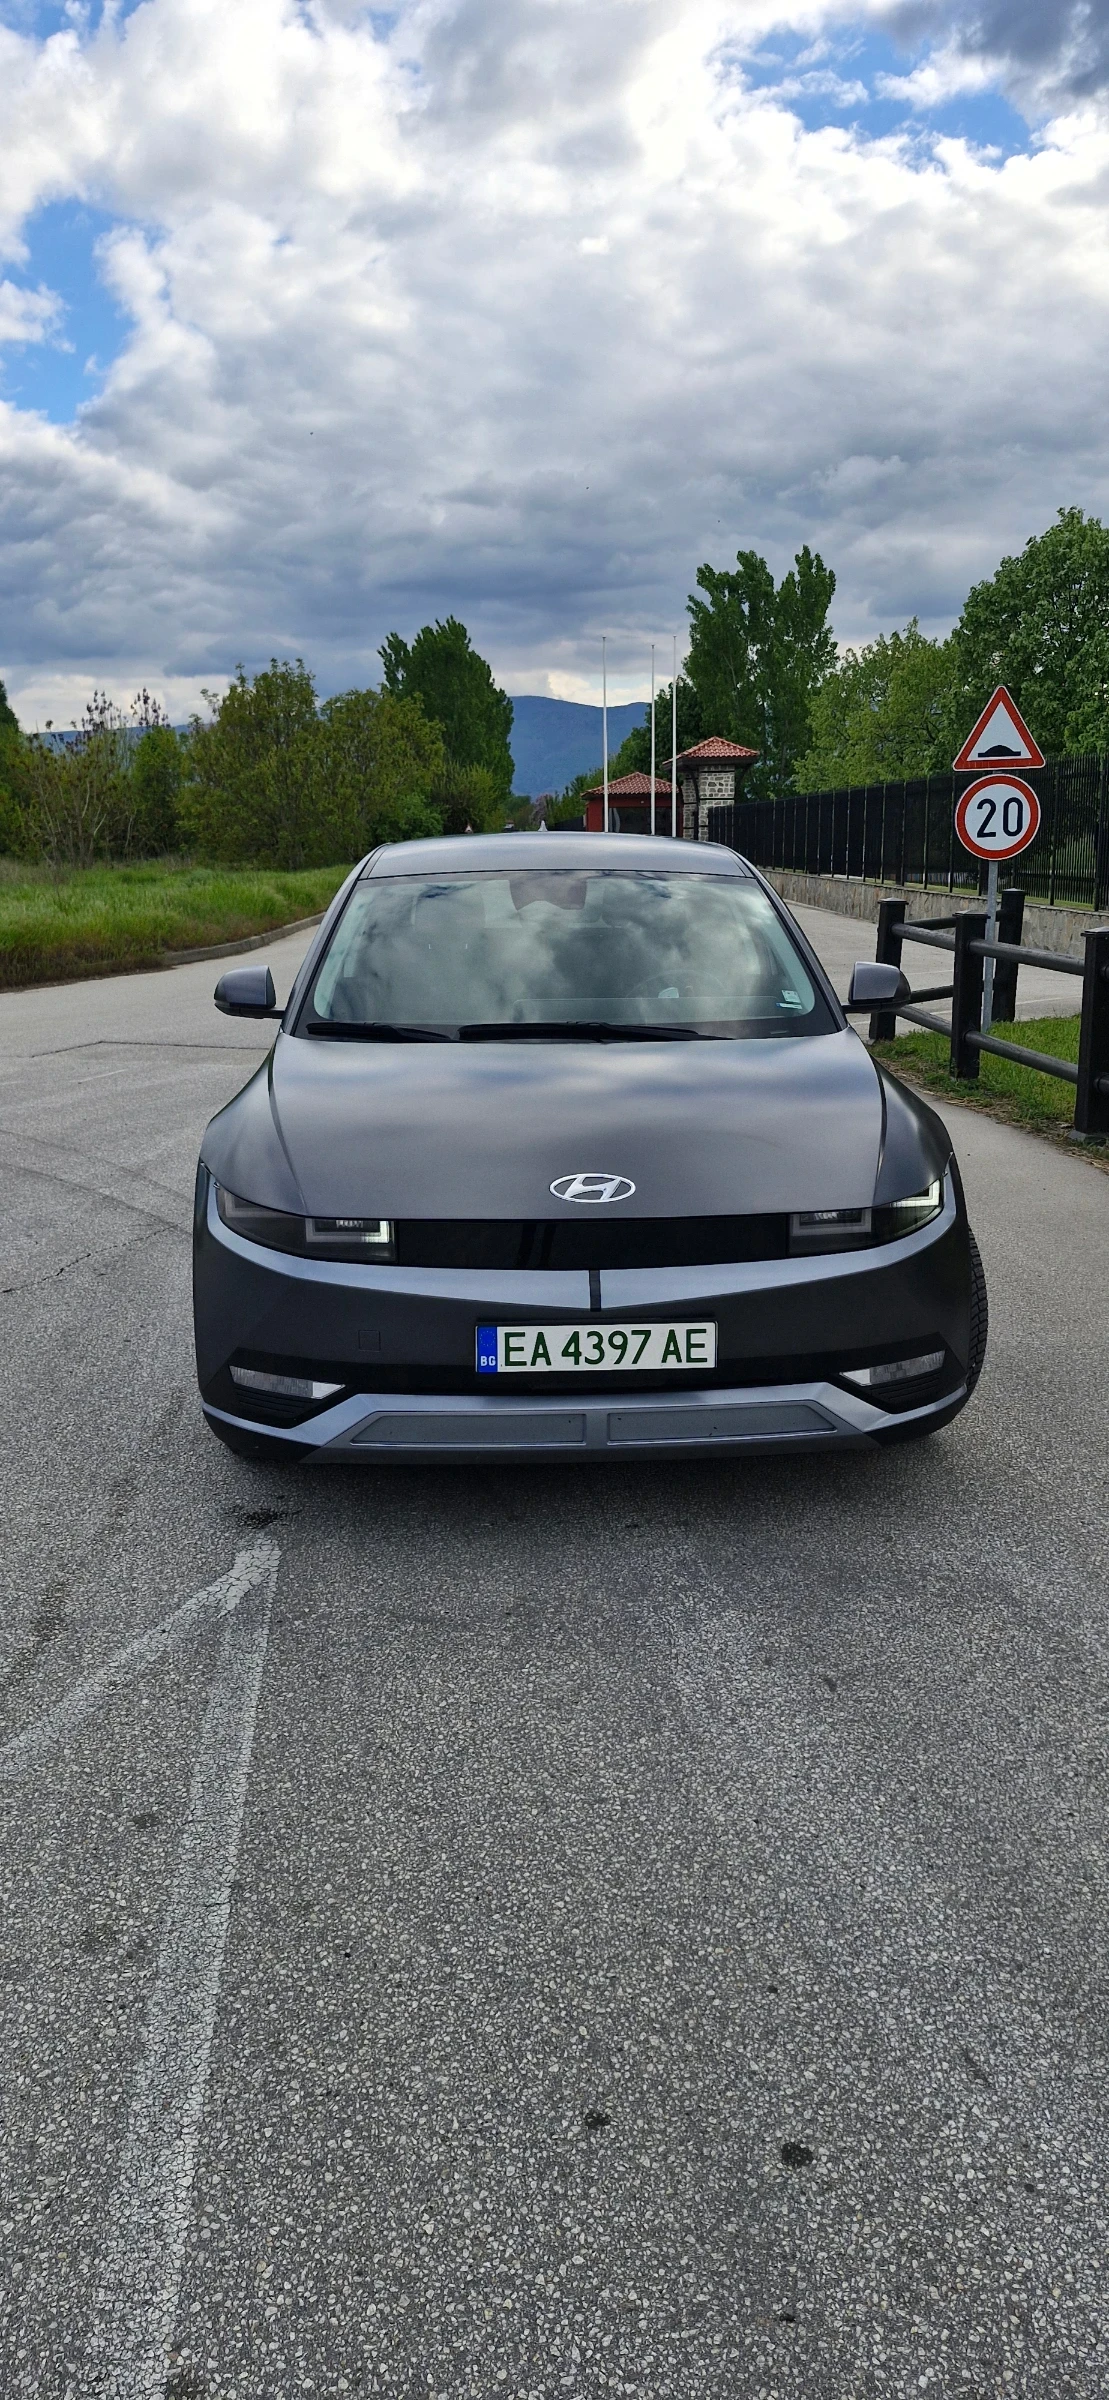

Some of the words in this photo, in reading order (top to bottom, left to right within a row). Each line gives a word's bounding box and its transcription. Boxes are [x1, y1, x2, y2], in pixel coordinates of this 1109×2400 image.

[976, 797, 1024, 838] 20
[480, 1355, 496, 1366] BG
[503, 1331, 552, 1367] EA
[561, 1329, 652, 1366] 4397
[661, 1328, 708, 1364] AE
